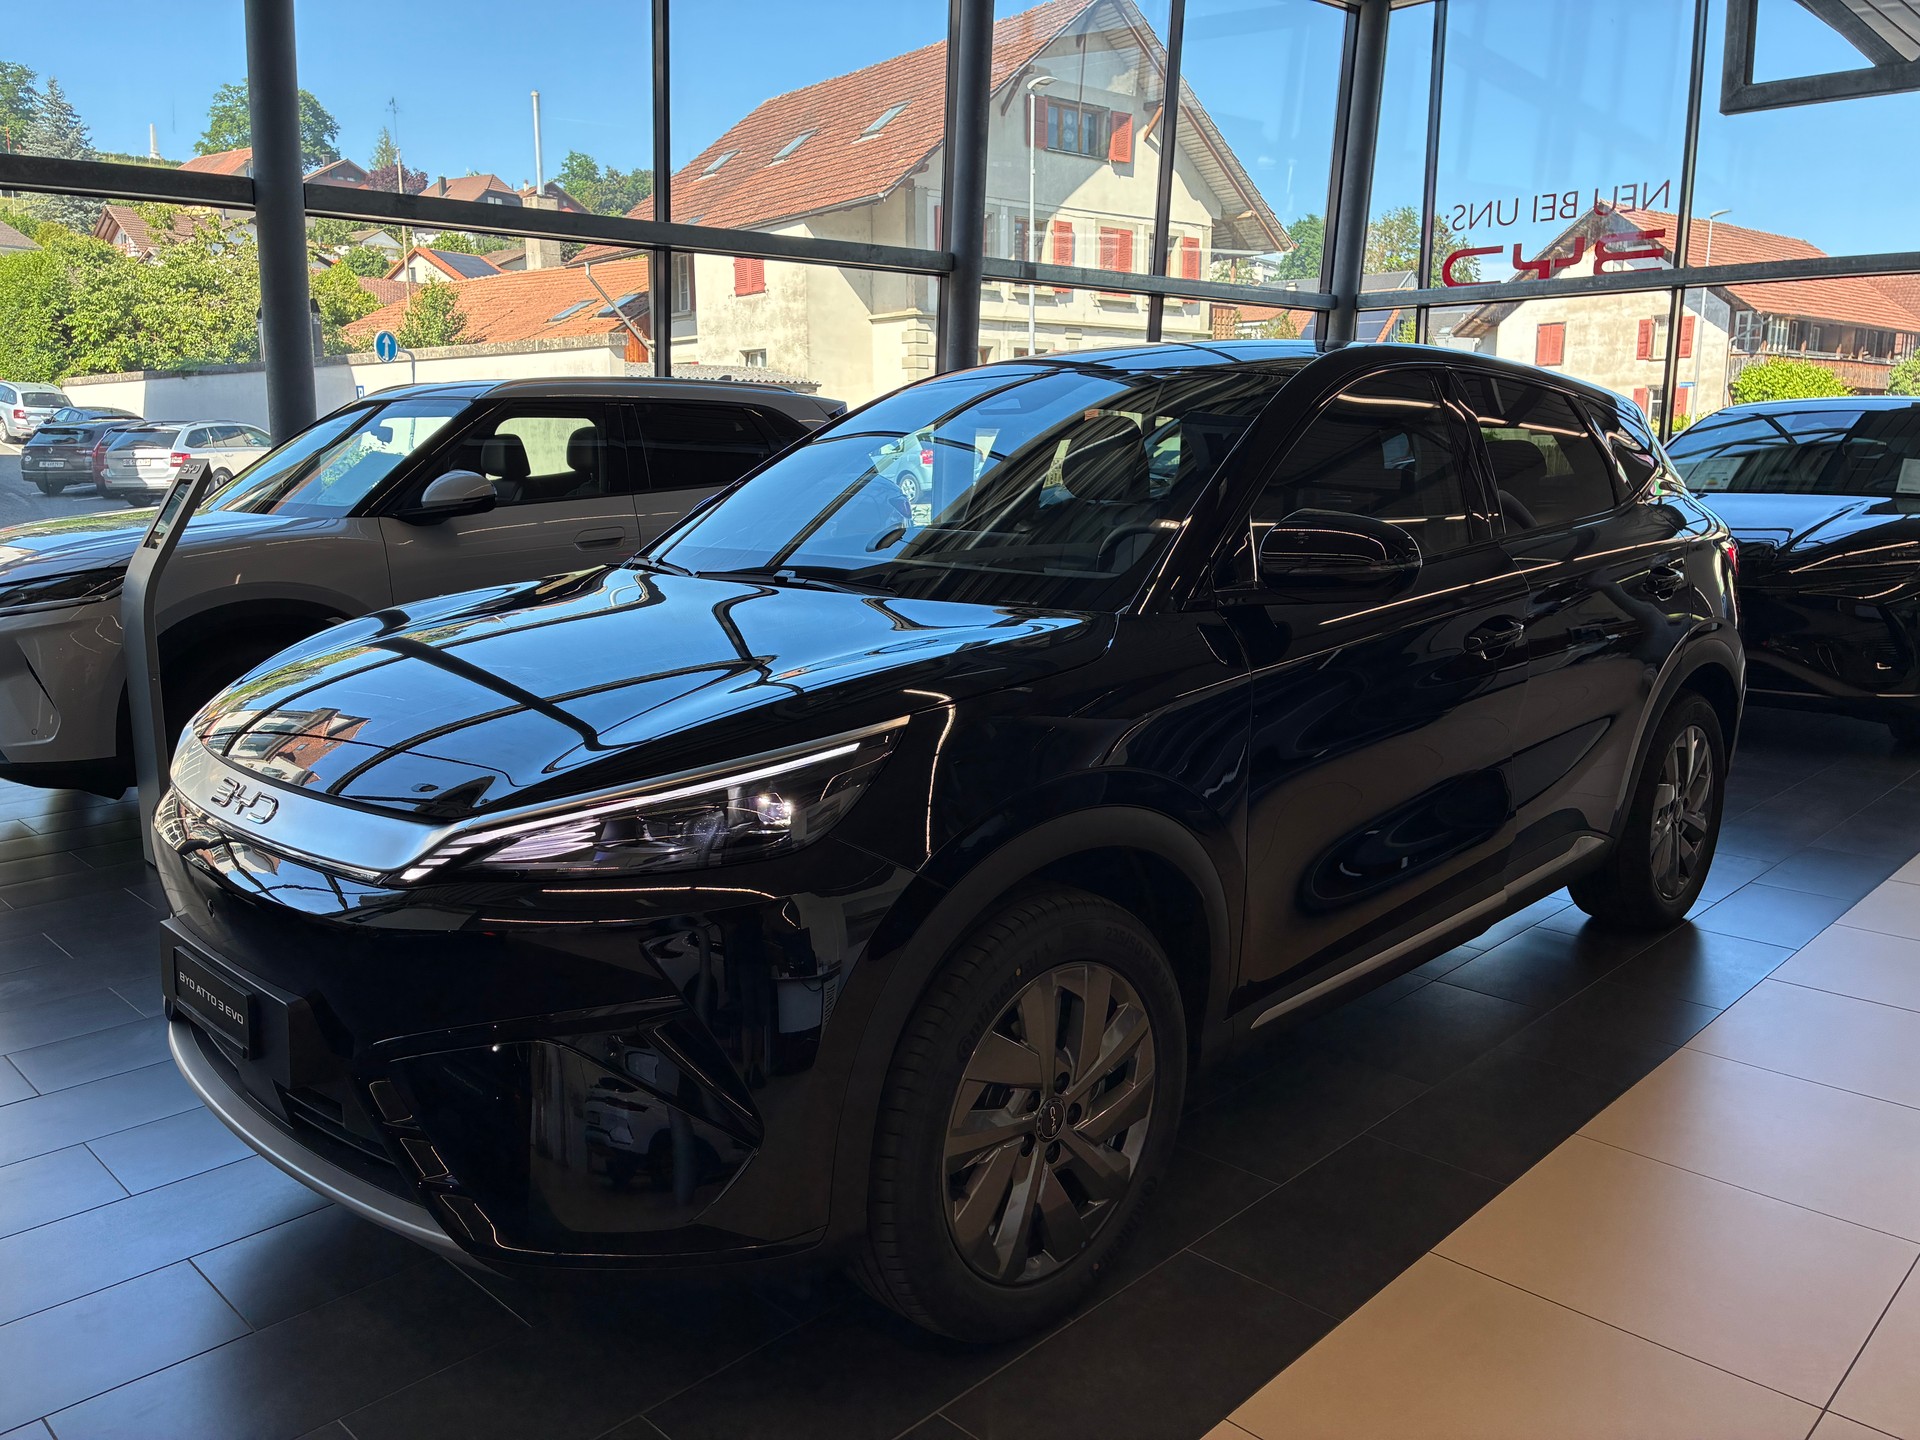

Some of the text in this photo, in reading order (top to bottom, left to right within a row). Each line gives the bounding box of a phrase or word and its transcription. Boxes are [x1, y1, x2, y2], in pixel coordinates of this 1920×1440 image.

[181, 464, 201, 474] BYD
[211, 777, 279, 825] BYD
[179, 971, 244, 1025] BYD ATTO 3 EVO
